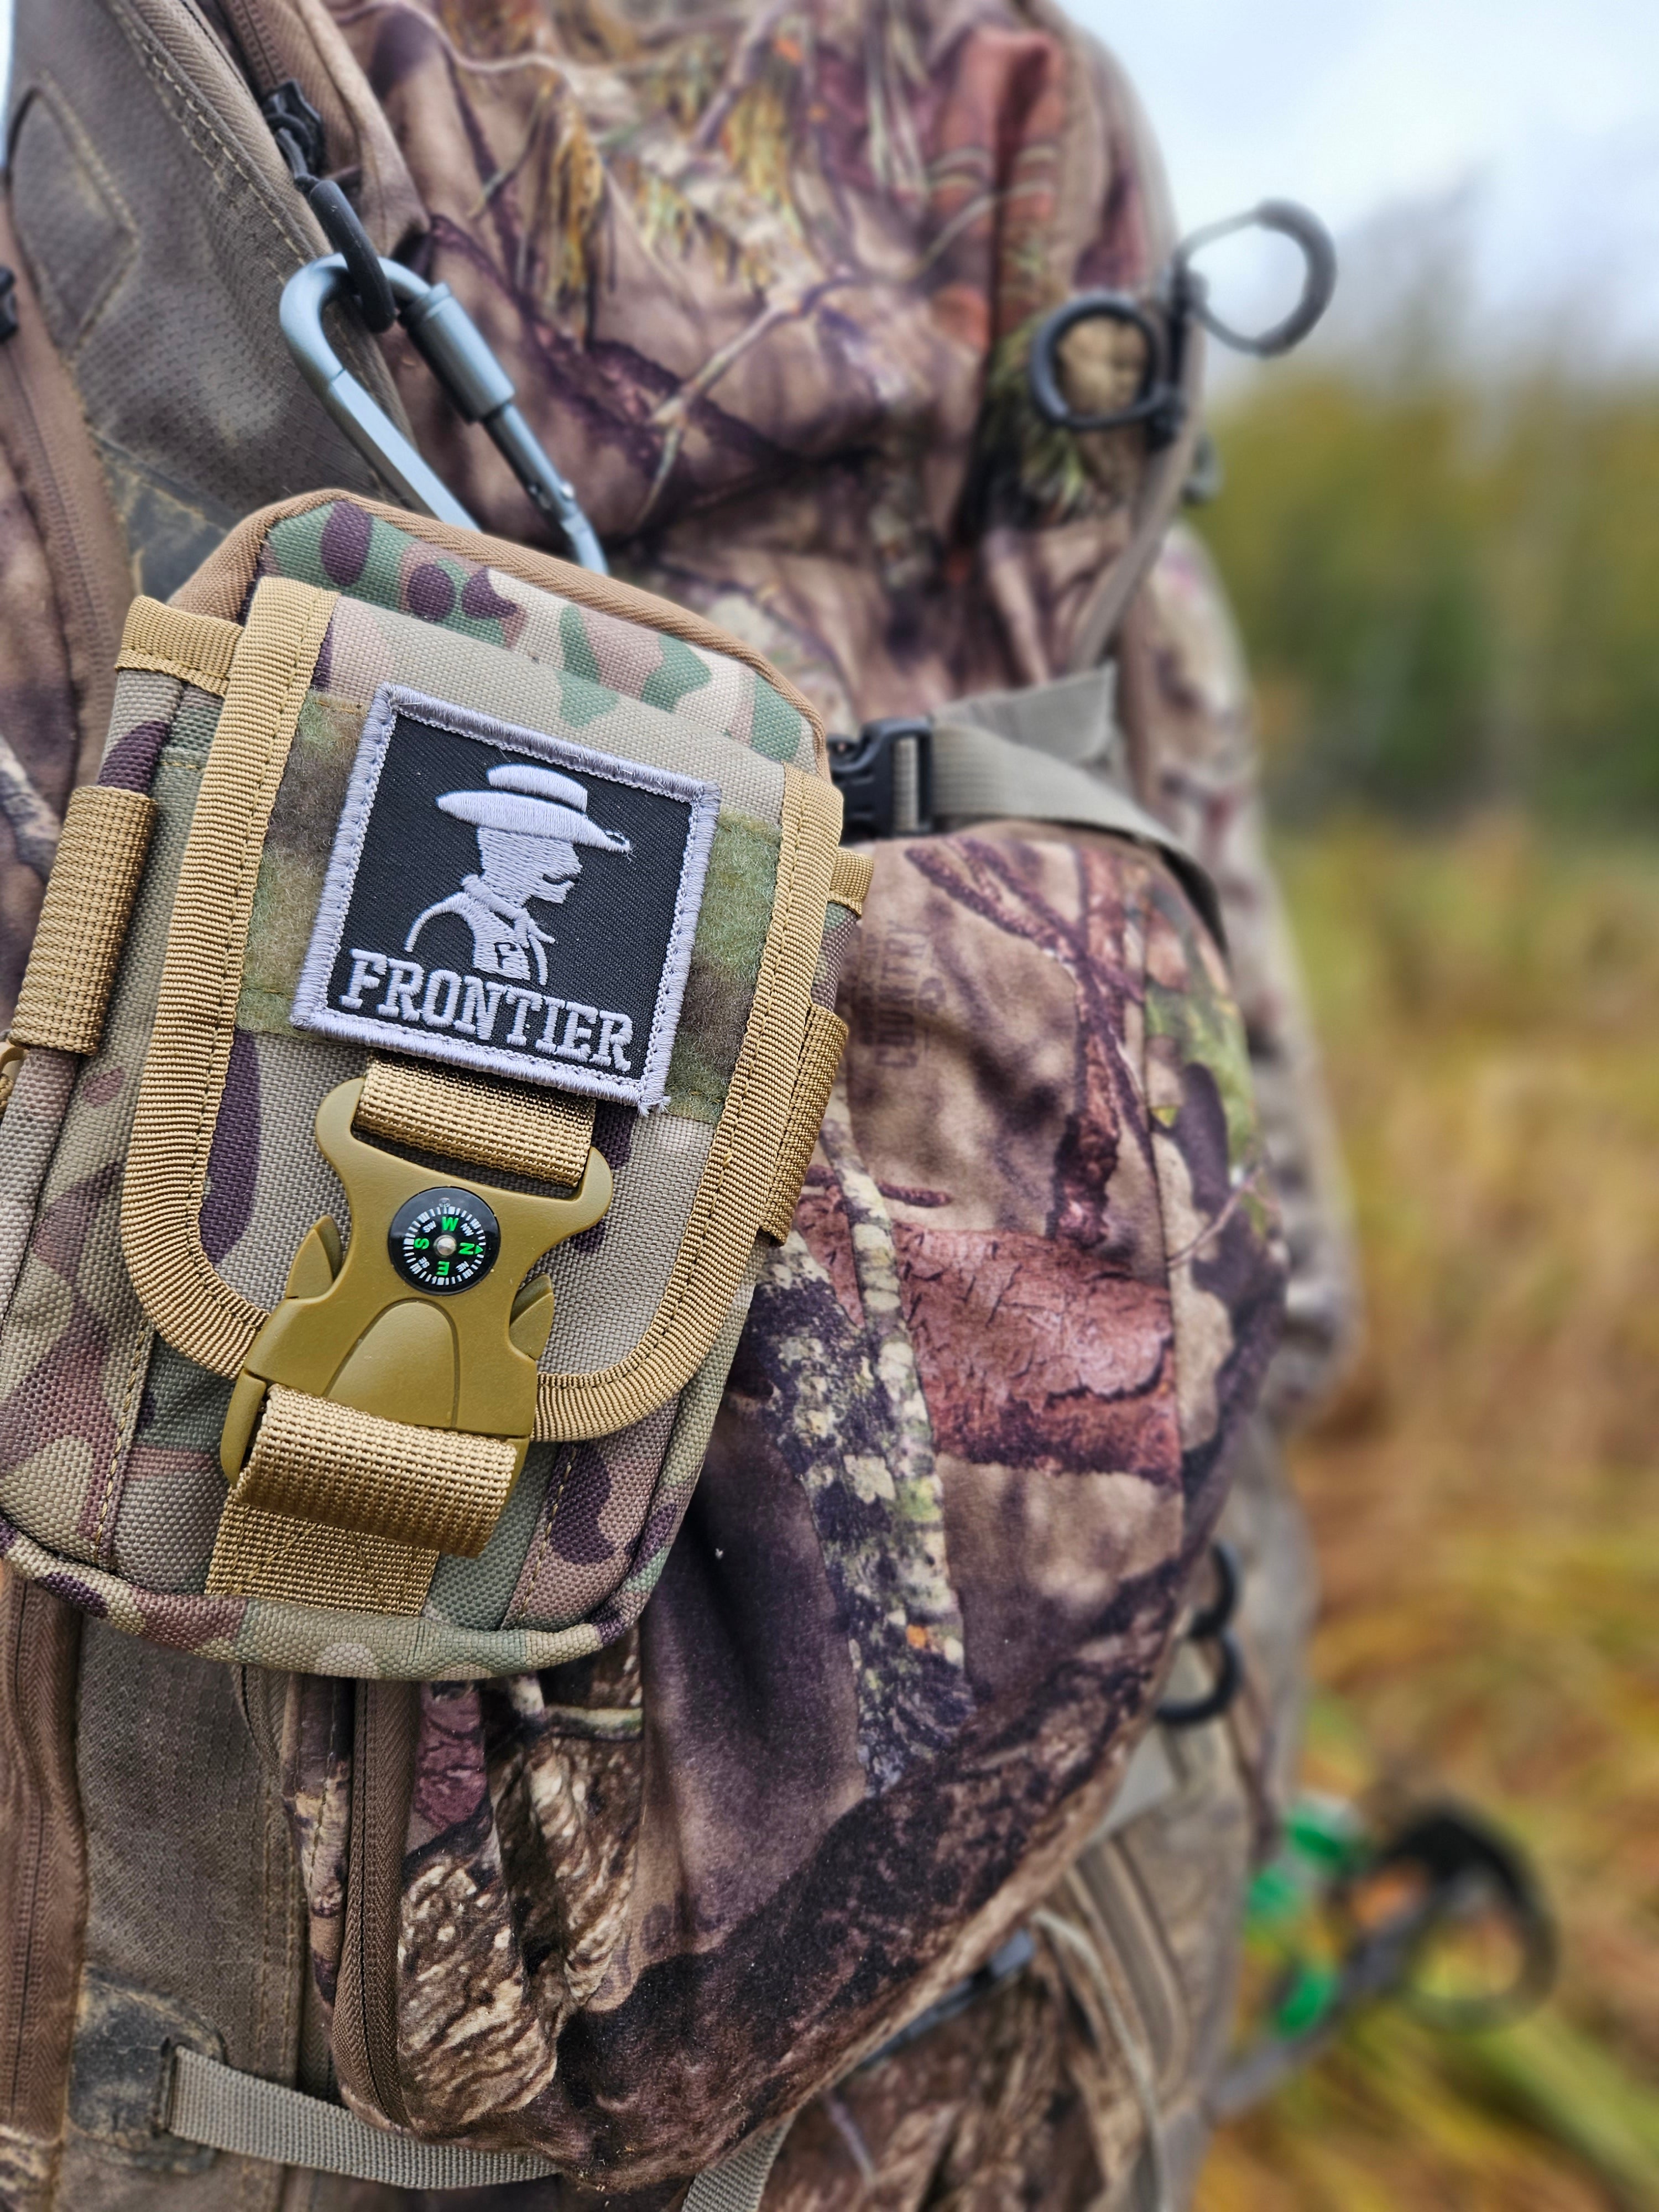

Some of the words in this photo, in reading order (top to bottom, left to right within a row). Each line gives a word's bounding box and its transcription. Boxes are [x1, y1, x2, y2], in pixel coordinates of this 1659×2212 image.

[339, 948, 633, 1072] FRONTIER
[422, 1220, 436, 1233] SW
[442, 1216, 459, 1232] W
[460, 1223, 474, 1237] NW
[414, 1238, 430, 1250] S
[458, 1242, 475, 1255] N
[418, 1256, 430, 1269] SE
[435, 1261, 450, 1276] E
[456, 1261, 469, 1272] NE
